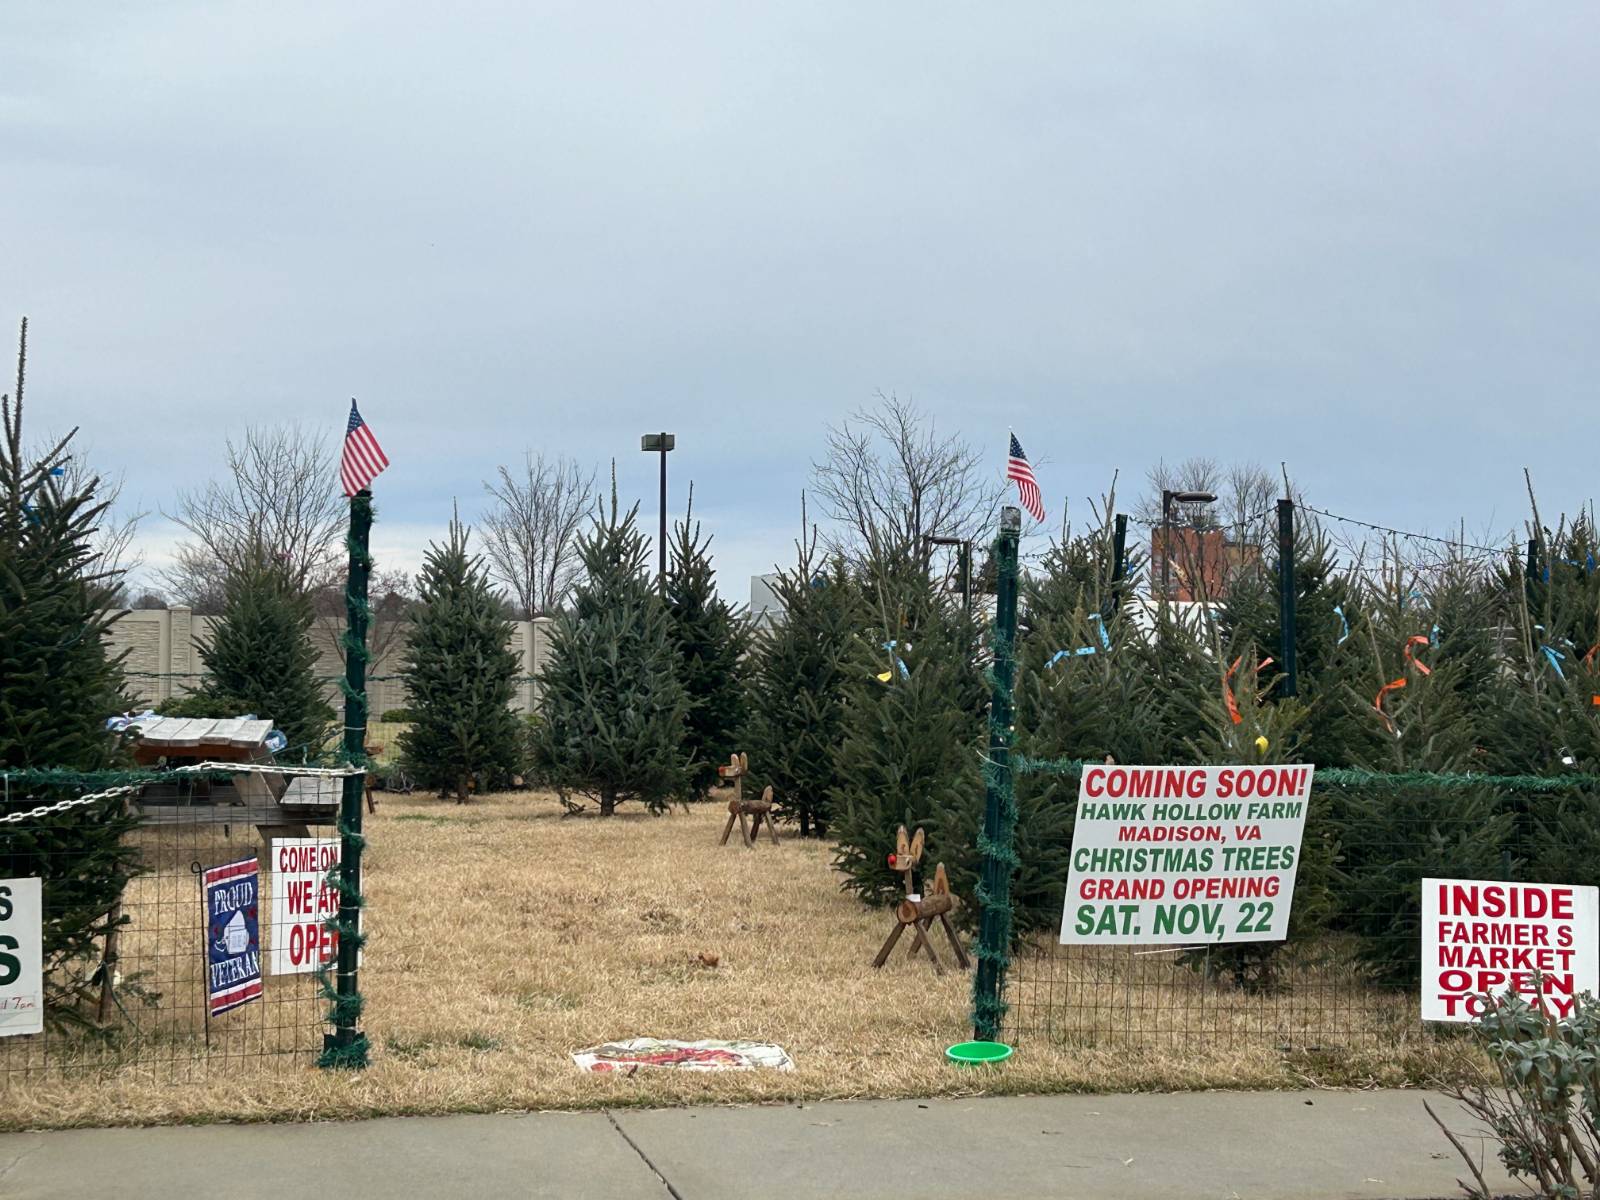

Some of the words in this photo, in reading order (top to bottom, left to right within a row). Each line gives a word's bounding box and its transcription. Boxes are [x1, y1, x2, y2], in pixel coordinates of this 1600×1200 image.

[1085, 769, 1207, 798] COMING
[1215, 768, 1308, 798] SOON!
[1080, 803, 1147, 821] HAWK
[1152, 803, 1242, 821] HOLLOW
[1247, 802, 1302, 820] FARM
[1118, 826, 1226, 844] MADISON,
[1235, 825, 1262, 841] VA
[279, 846, 317, 873] COME
[1073, 847, 1214, 873] CHRISTMAS
[1222, 845, 1295, 871] TREES
[214, 881, 253, 915] PROUD
[287, 880, 313, 915] WE
[317, 878, 340, 913] AR
[1079, 878, 1165, 900] GRAND
[1173, 876, 1280, 900] OPENING
[1438, 884, 1574, 920] INSIDE
[1074, 904, 1141, 936] SAT.
[1152, 903, 1225, 941] NOV,
[1235, 901, 1274, 934] 22
[210, 951, 260, 988] VETERAN
[1438, 945, 1576, 971] MARKET
[1438, 970, 1574, 995] OPEN
[1437, 993, 1576, 1020] TOY
